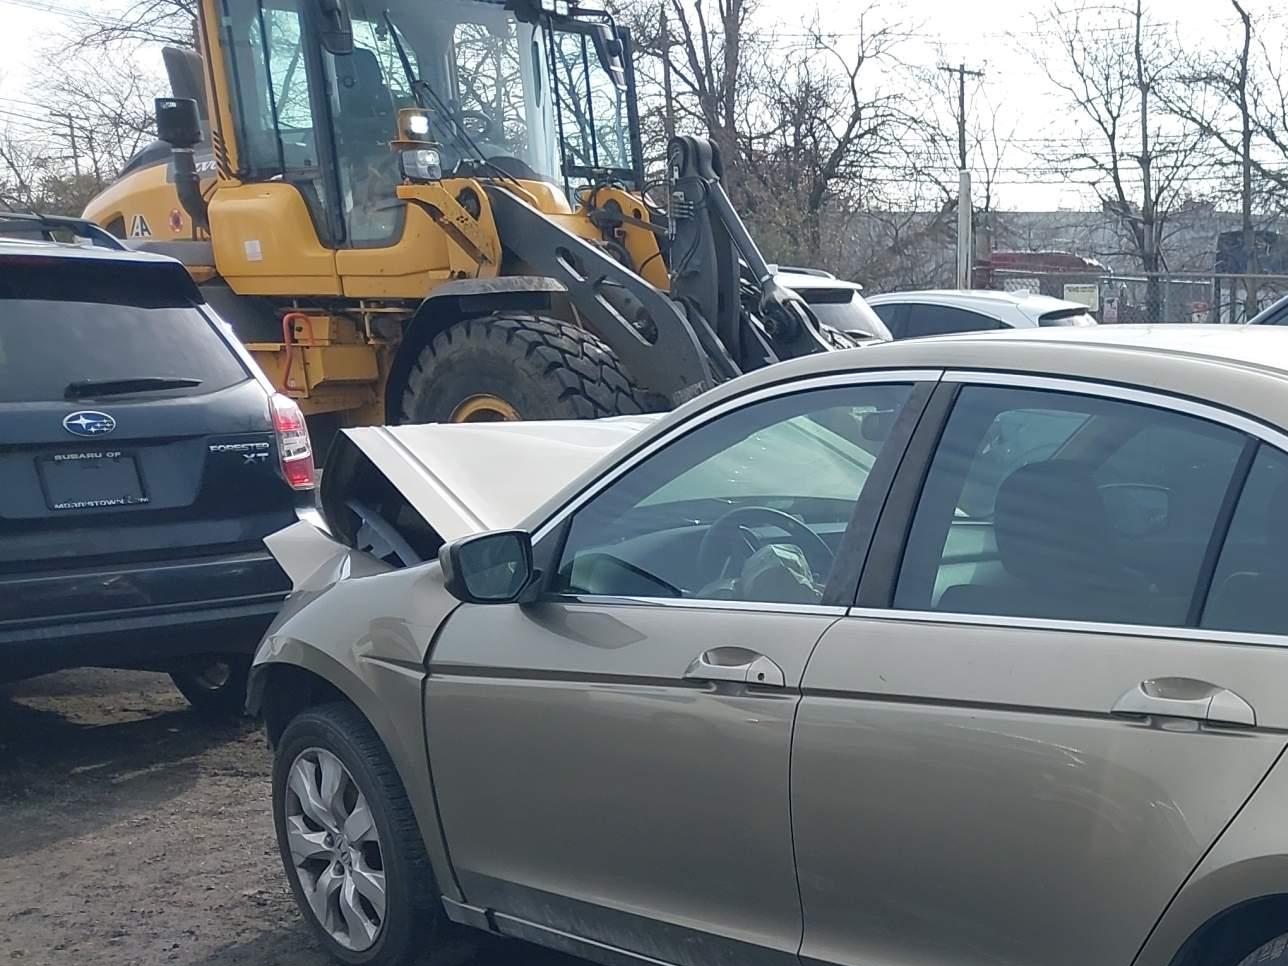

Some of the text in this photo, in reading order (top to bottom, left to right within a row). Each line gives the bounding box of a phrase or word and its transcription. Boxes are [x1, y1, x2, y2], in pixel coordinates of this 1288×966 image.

[208, 442, 270, 453] FORESTER
[54, 452, 102, 461] SUBARU
[242, 452, 269, 464] XT
